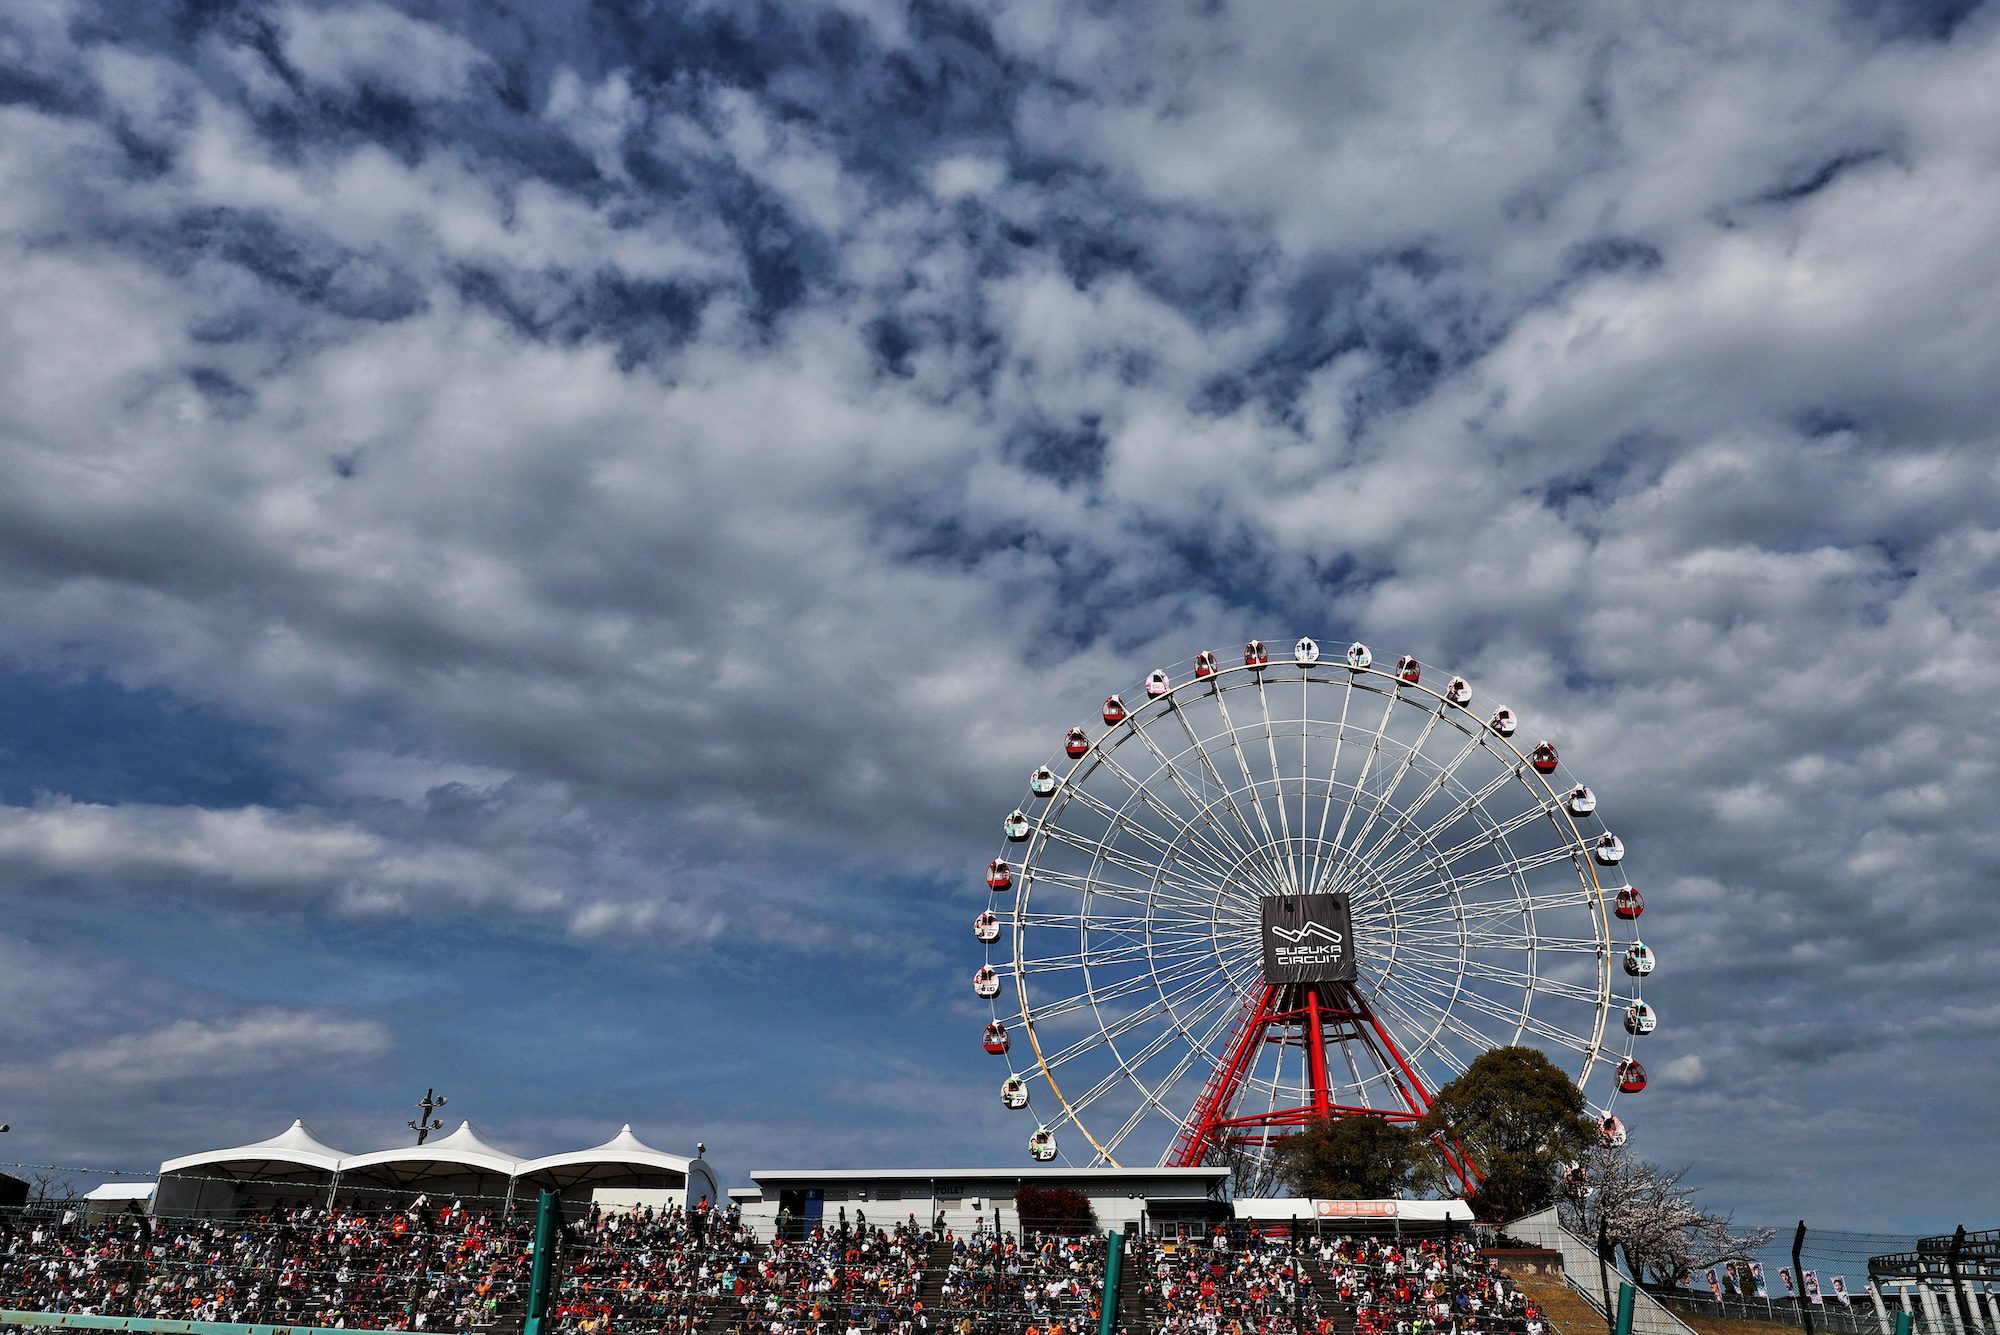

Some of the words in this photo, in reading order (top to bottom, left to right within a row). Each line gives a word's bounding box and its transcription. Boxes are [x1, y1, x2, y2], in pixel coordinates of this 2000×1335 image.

[1275, 945, 1342, 955] SUZUKA
[1278, 955, 1341, 965] CIRCUIT
[935, 1186, 965, 1194] TOILET
